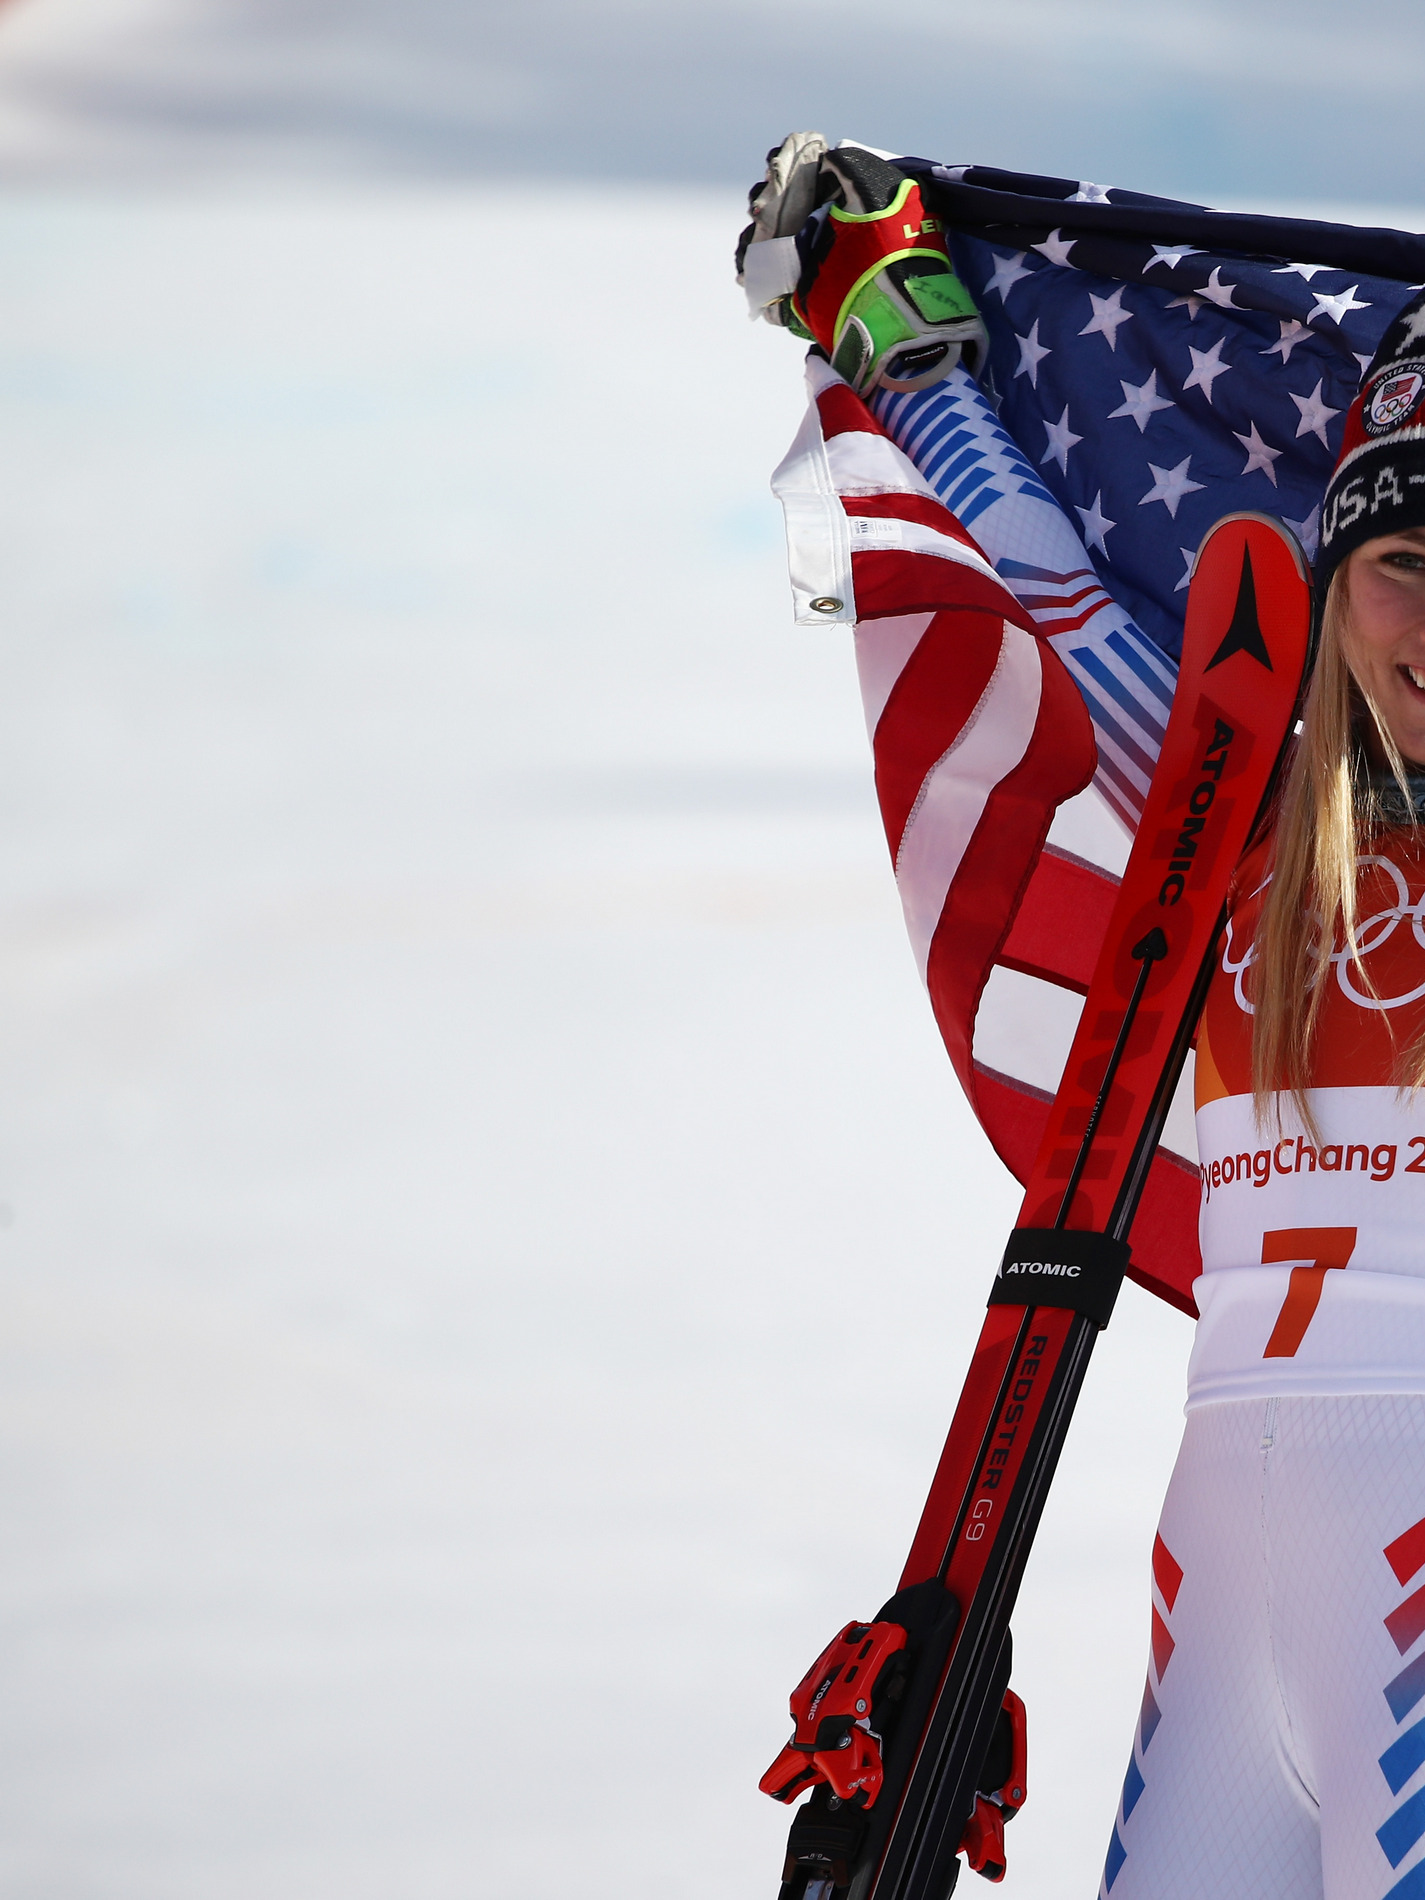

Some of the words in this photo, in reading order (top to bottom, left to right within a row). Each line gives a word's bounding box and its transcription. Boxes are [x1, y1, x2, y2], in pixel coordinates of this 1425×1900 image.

[1373, 366, 1404, 389] UNITED
[1365, 421, 1391, 434] OLYMPIC
[1394, 404, 1415, 425] TEAM
[1158, 717, 1236, 908] ATOMIC
[1006, 1261, 1082, 1279] ATOMIC
[1260, 1226, 1358, 1360] 7
[980, 1335, 1048, 1490] REDSTER
[965, 1498, 993, 1541] G9
[807, 1679, 831, 1722] ATOMIC
